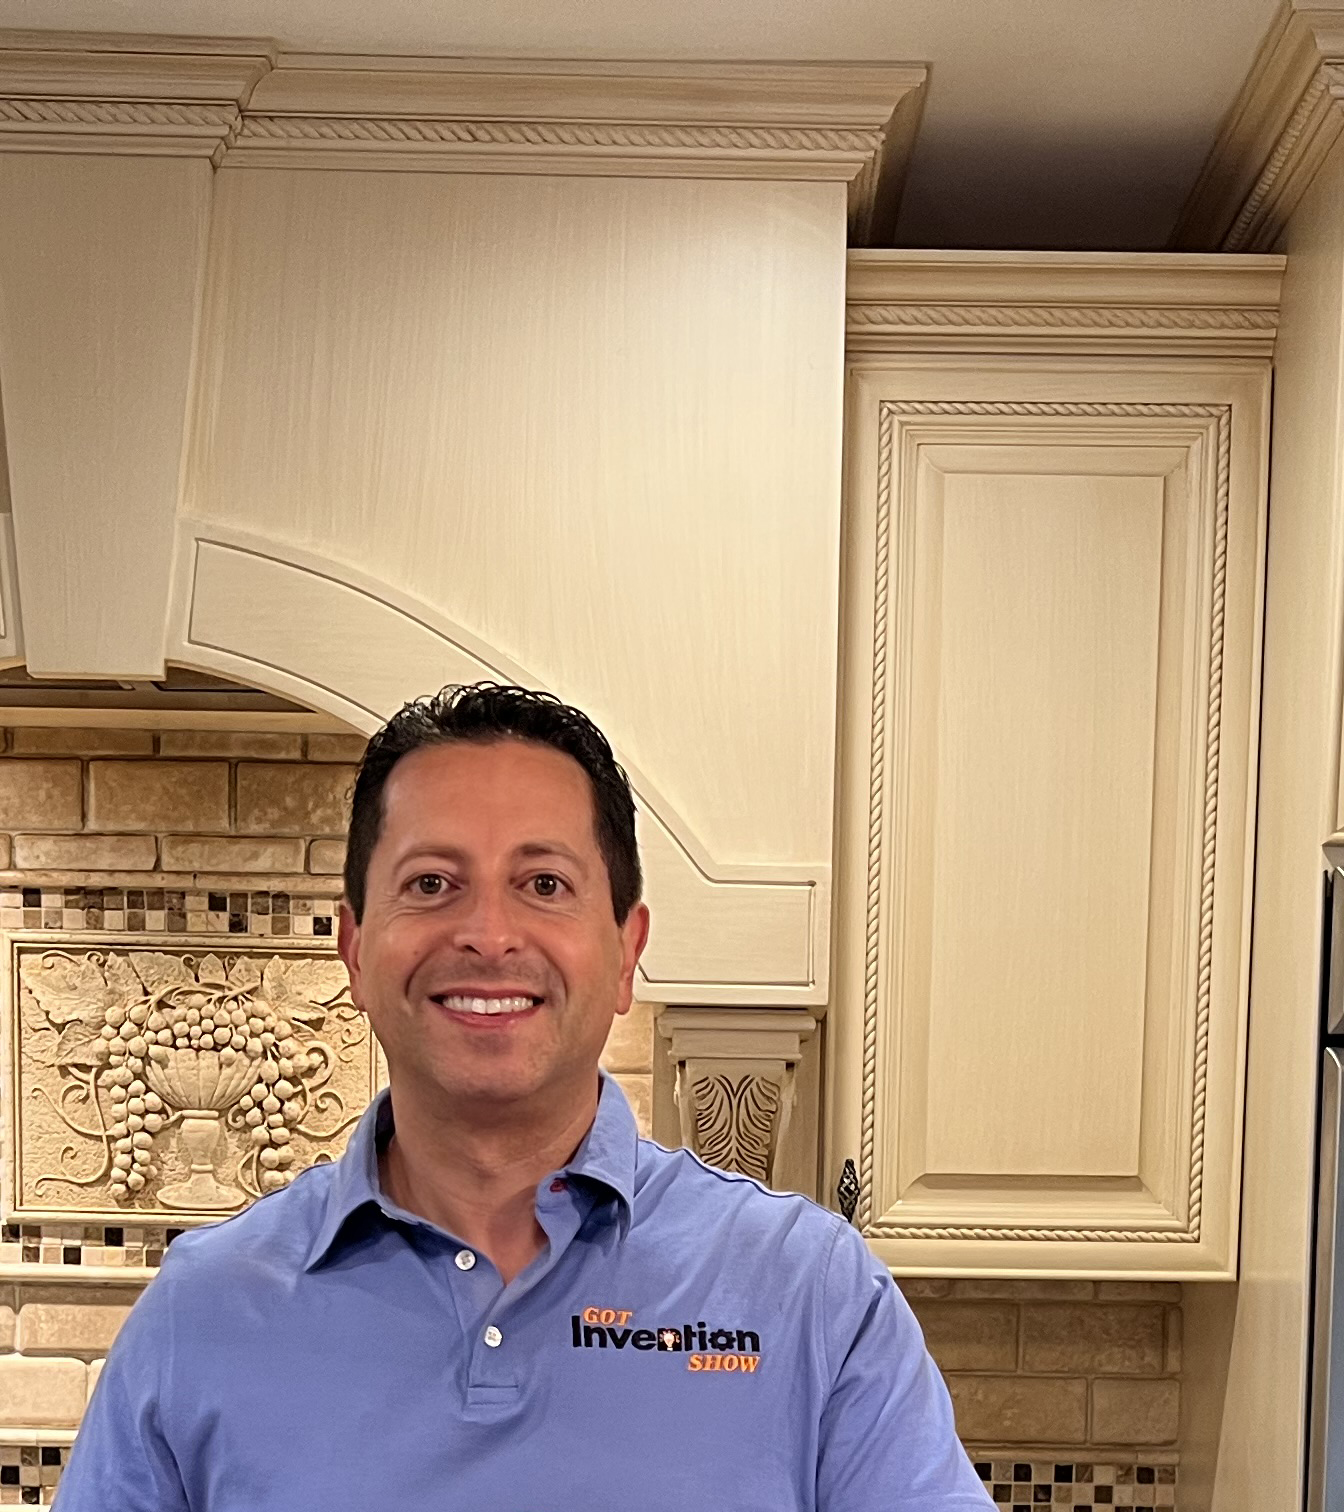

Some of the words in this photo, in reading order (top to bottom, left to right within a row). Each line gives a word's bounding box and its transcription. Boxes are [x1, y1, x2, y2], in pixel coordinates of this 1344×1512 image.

[583, 1306, 632, 1326] GOT
[571, 1315, 760, 1352] Invention
[688, 1353, 760, 1373] SHOW
